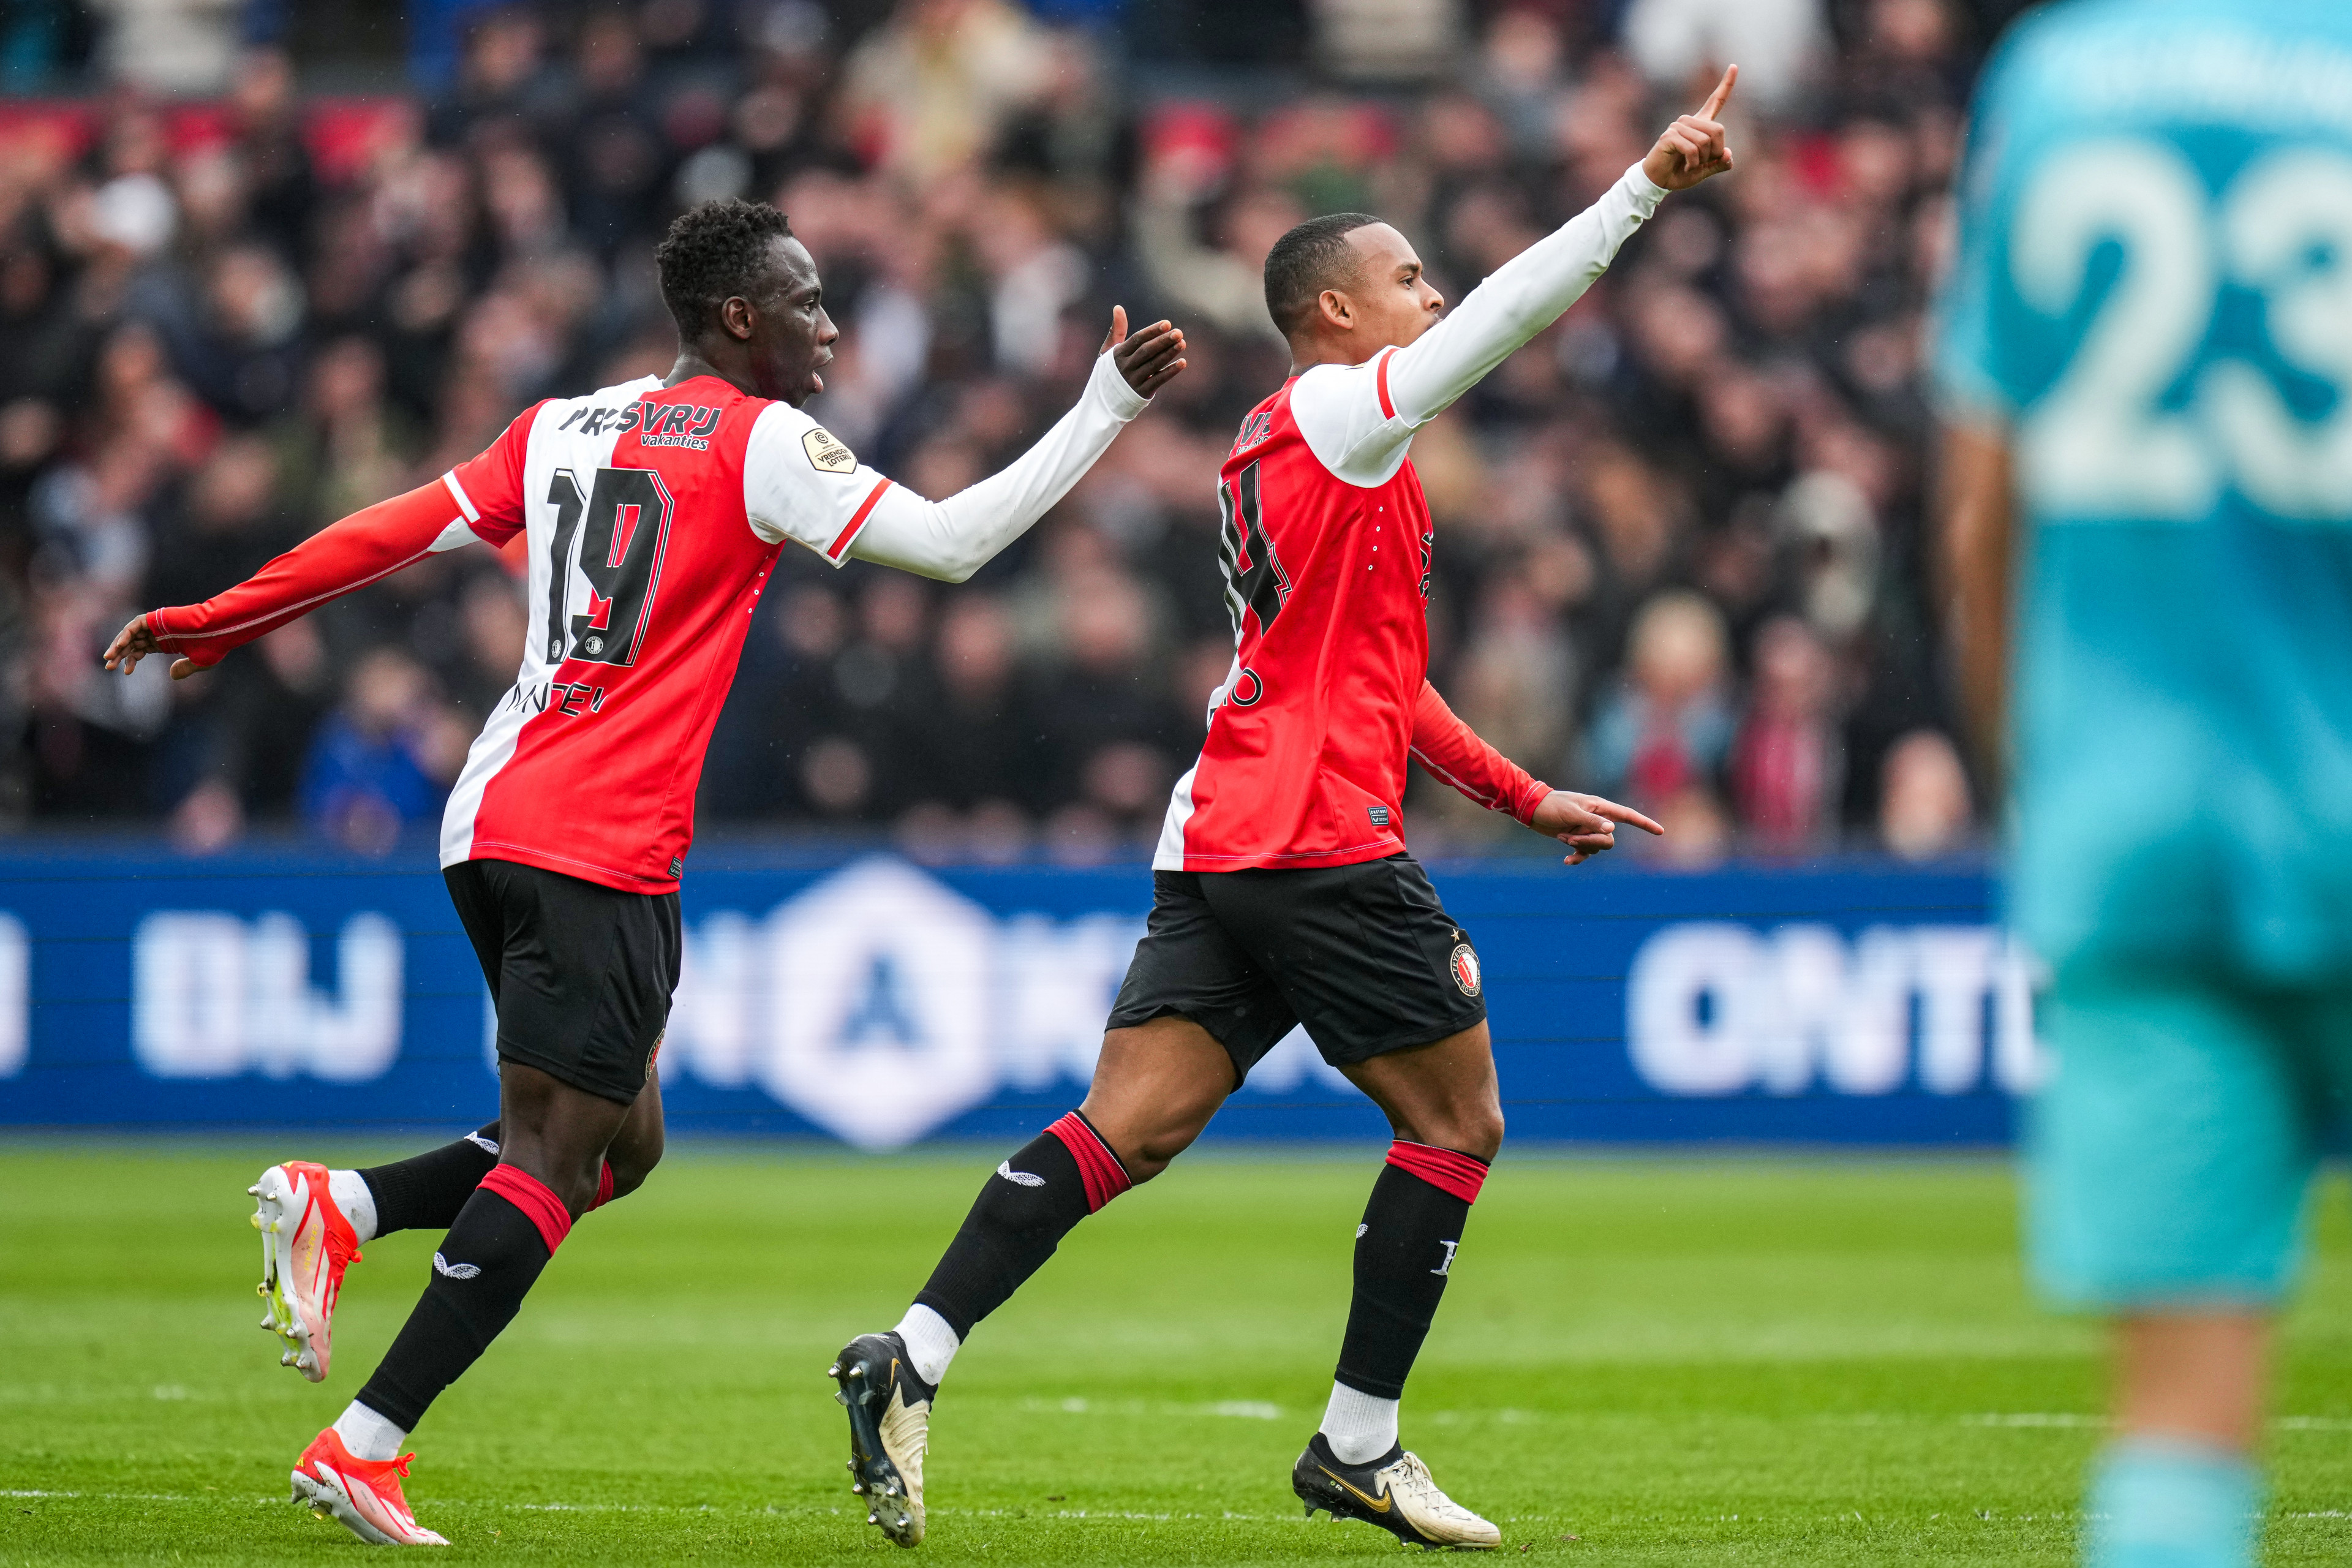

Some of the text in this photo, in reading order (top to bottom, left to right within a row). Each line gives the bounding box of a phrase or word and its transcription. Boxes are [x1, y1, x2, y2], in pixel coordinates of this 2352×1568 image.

[641, 433, 709, 450] vakanties
[827, 453, 851, 467] LOTERIJ
[546, 467, 674, 666] 19
[1452, 946, 1475, 971] FEYENOORD
